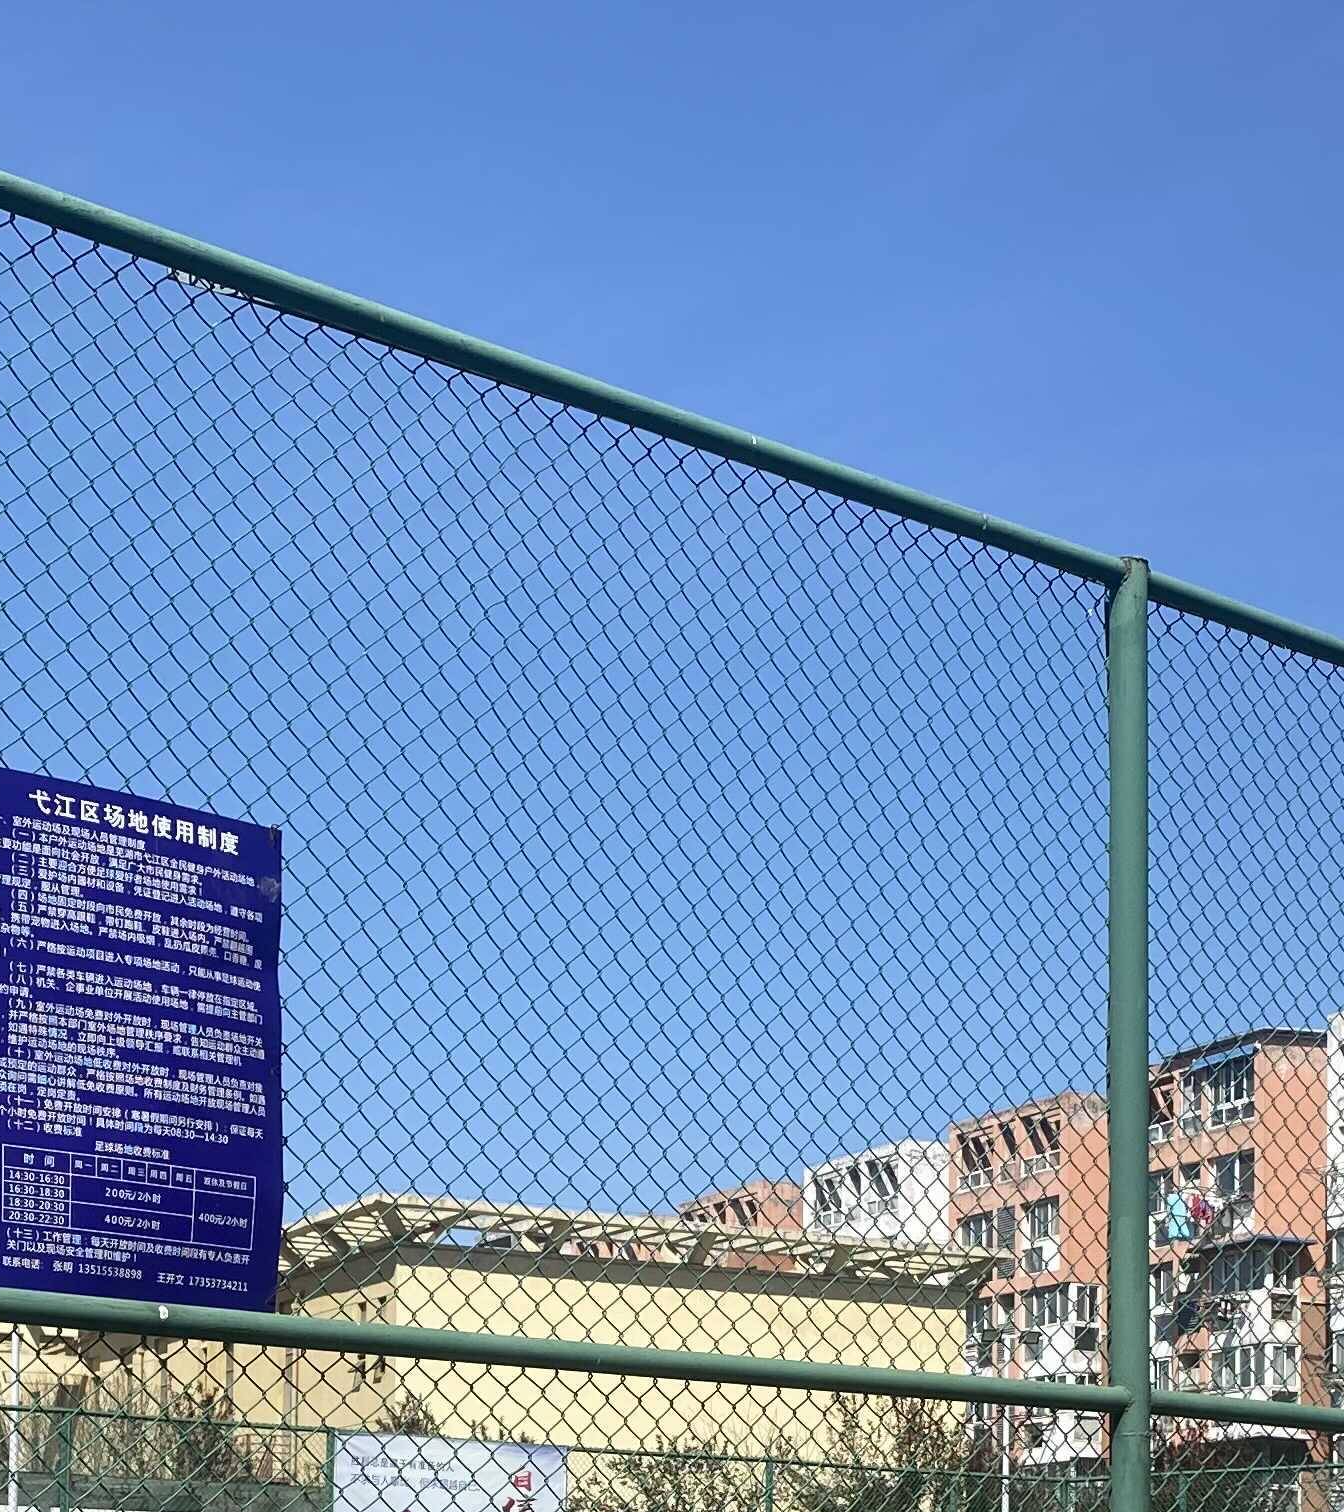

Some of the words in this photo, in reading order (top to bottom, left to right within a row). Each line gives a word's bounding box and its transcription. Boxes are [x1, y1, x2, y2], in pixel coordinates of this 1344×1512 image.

[27, 787, 240, 856] 弋江区场地使用制度
[94, 1140, 170, 1160] 足球场地收费标准
[8, 1169, 64, 1185] 14:30-16:30
[8, 1183, 64, 1198] 16:30-18:30
[8, 1196, 64, 1212] 18:30-20:30
[8, 1210, 64, 1225] 20:30-22:30
